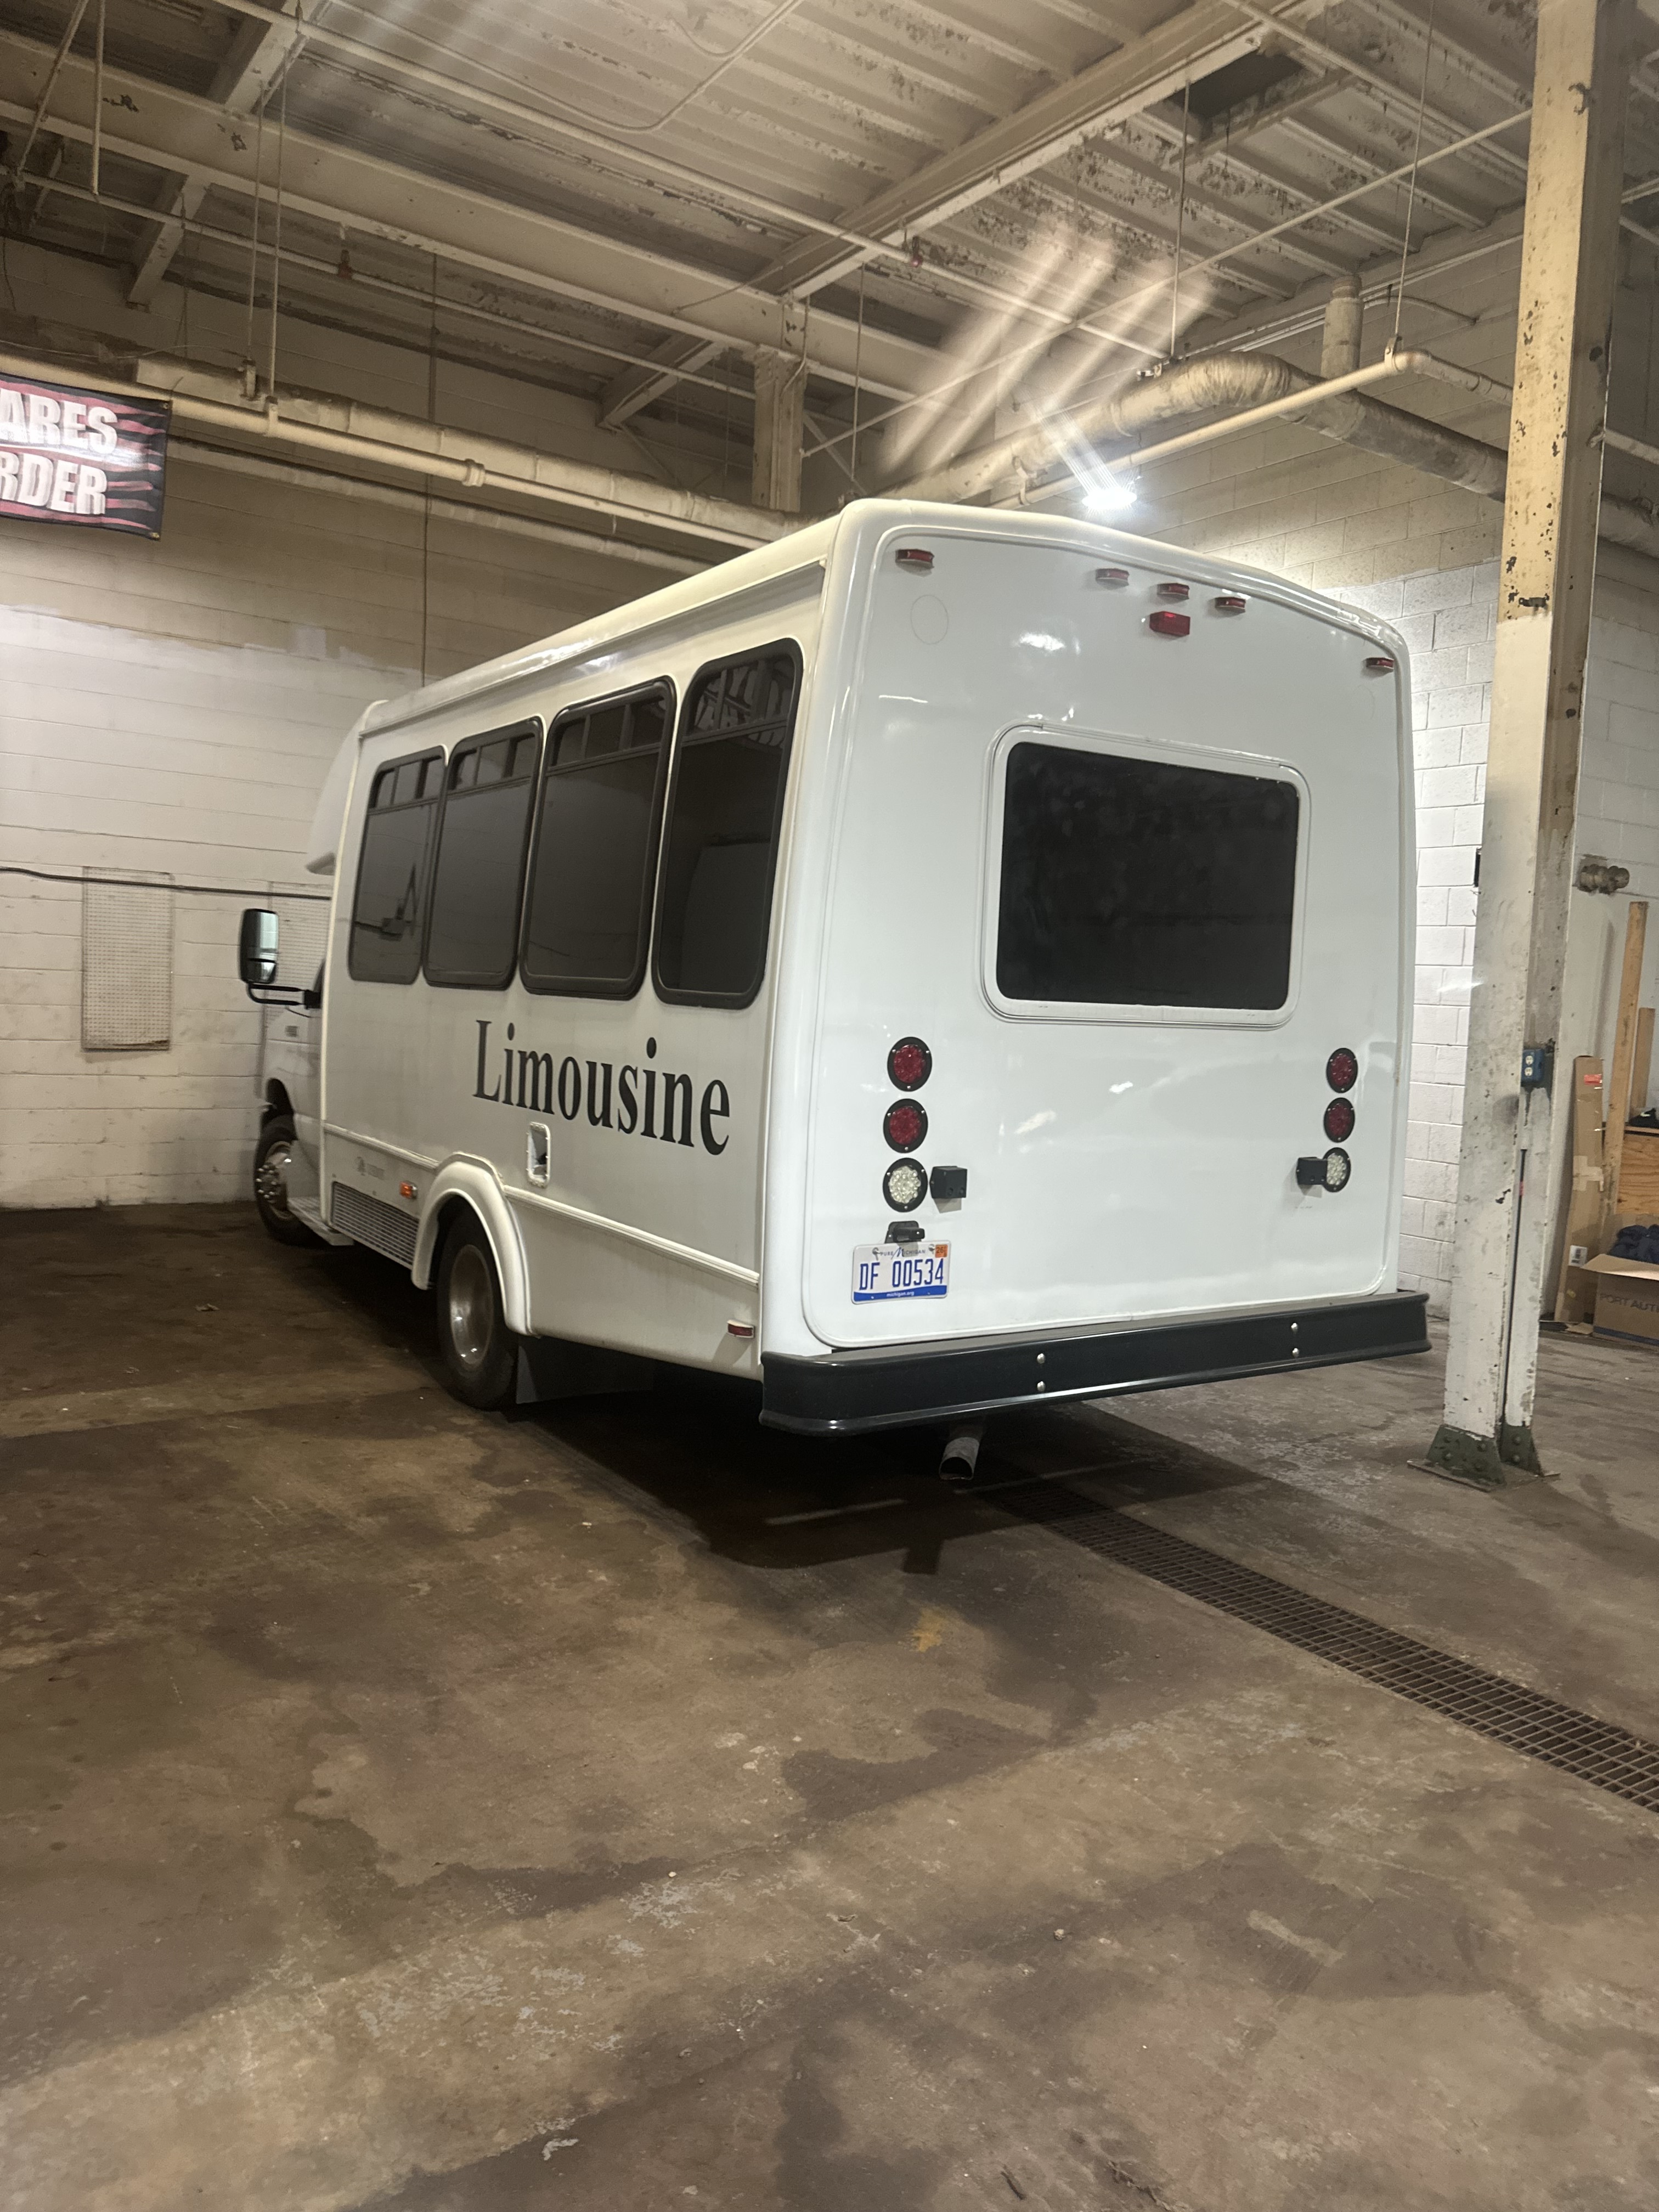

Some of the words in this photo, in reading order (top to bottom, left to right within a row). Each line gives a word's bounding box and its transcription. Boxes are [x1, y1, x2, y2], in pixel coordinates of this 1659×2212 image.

[0, 388, 117, 454] ARES
[0, 450, 108, 515] RDER
[472, 1020, 730, 1155] Limousine
[860, 1262, 880, 1290] DF
[893, 1259, 944, 1287] 00534
[891, 1247, 926, 1260] MICHIGAN
[1600, 1293, 1629, 1306] PORT
